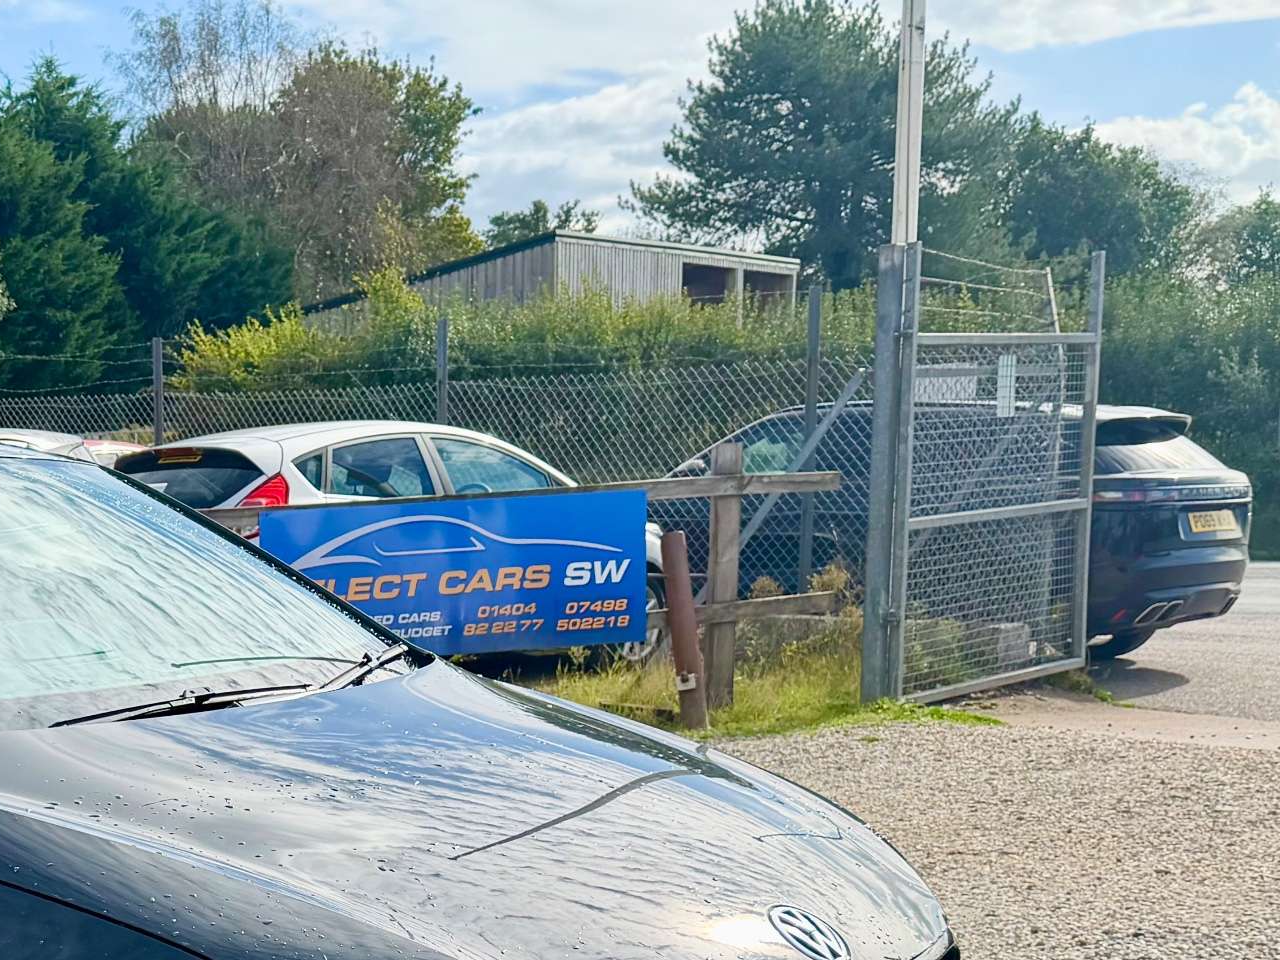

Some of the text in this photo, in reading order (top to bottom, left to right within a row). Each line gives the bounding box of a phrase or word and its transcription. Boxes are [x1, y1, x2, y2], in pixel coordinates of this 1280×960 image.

[314, 558, 632, 602] LECT CARS SW
[477, 602, 537, 619] 01404
[565, 598, 629, 615] 07498
[398, 611, 442, 624] CARS
[556, 614, 631, 632] 502218
